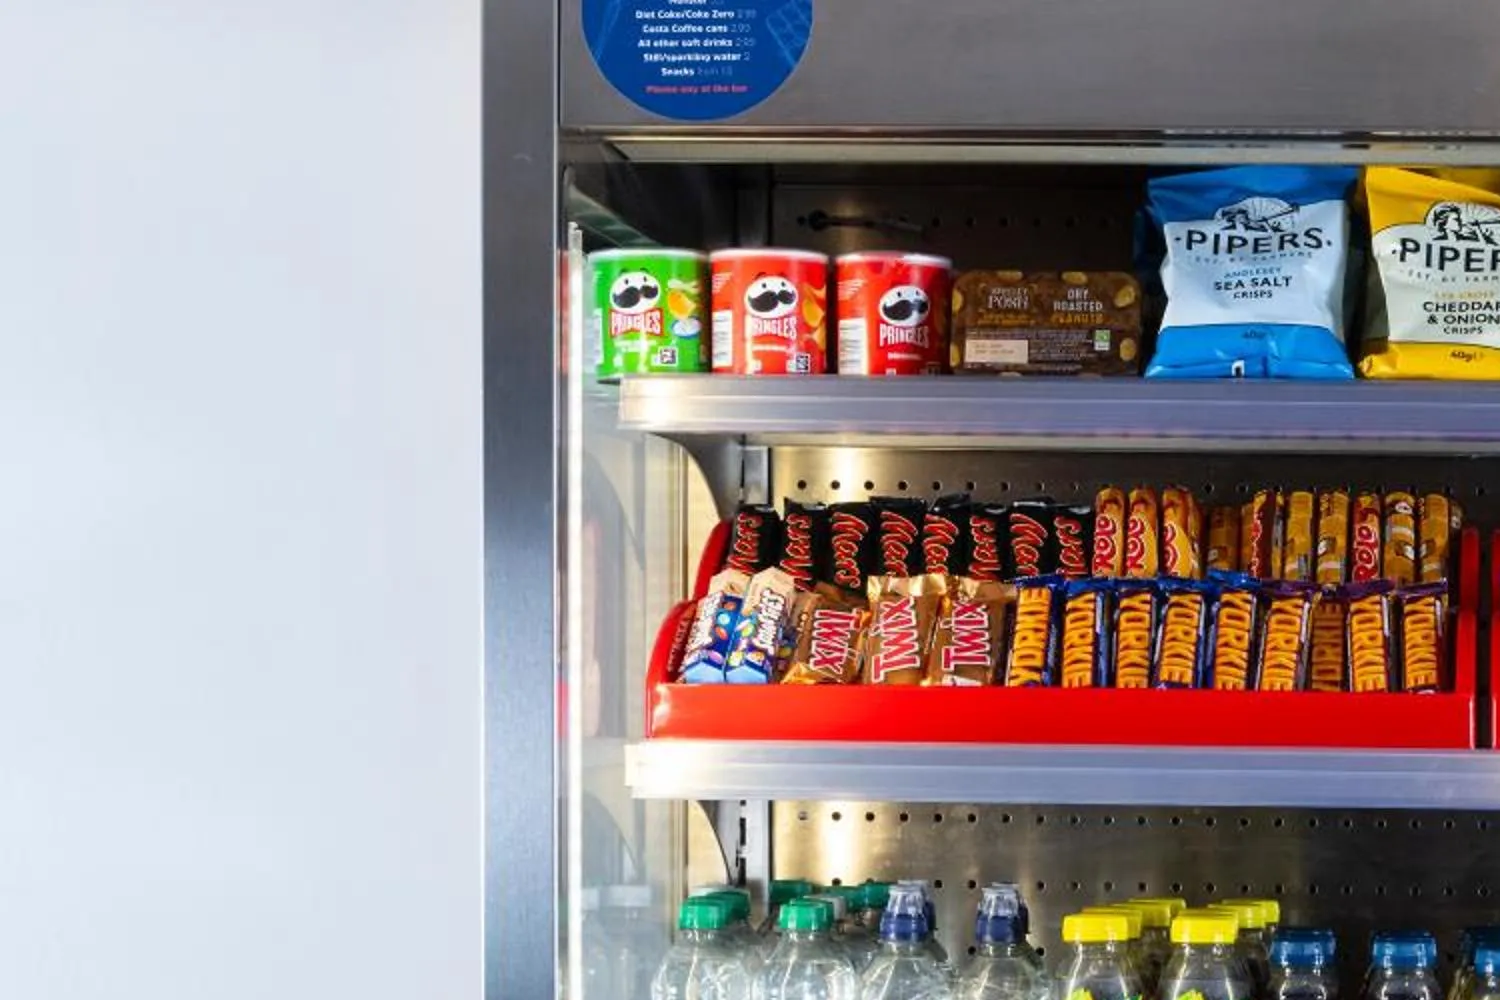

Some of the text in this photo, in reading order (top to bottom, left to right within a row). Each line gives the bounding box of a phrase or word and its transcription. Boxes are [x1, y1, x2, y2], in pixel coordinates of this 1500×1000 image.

[661, 67, 695, 76] Snacks
[1186, 227, 1324, 256] PIPERS
[1214, 276, 1293, 291] SEA SALT
[1233, 290, 1273, 299] CRISPS
[1053, 301, 1103, 312] ROASTED
[610, 309, 662, 337] PRINGLES
[1427, 314, 1500, 325] & ONION
[879, 323, 929, 348] PRINGLES
[1443, 326, 1483, 335] CRISPS
[781, 513, 813, 593] Mars
[831, 511, 869, 588] Mars
[968, 515, 1001, 582] Mars
